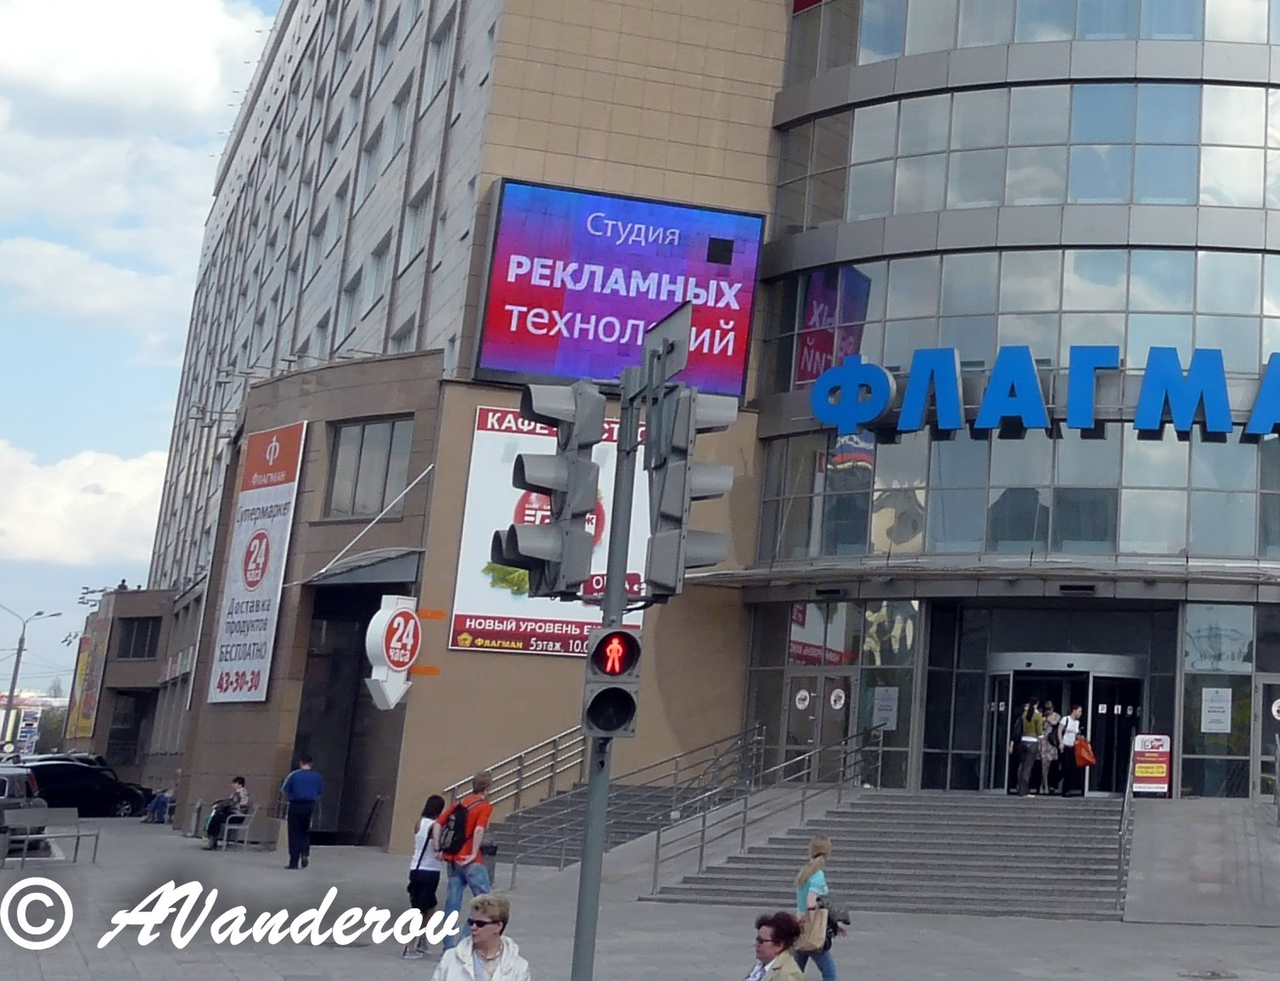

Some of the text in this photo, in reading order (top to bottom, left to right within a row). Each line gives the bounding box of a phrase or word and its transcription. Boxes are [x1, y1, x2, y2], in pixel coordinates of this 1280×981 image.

[586, 212, 680, 246] Студия
[506, 254, 742, 310] РЕКЛАМНЫХ
[505, 304, 736, 357] технолий
[247, 538, 267, 570] 24
[227, 598, 272, 619] Доставка
[224, 618, 268, 637] продуктов
[392, 616, 415, 651] 24
[465, 617, 517, 632] НОВЫЙ
[519, 620, 581, 635] УРОВЕНЬ
[218, 640, 268, 663] БЕСПЛАТНО
[389, 647, 411, 663] часа
[474, 637, 524, 650] ФЛАГМАН
[216, 669, 261, 694] 43-30-30
